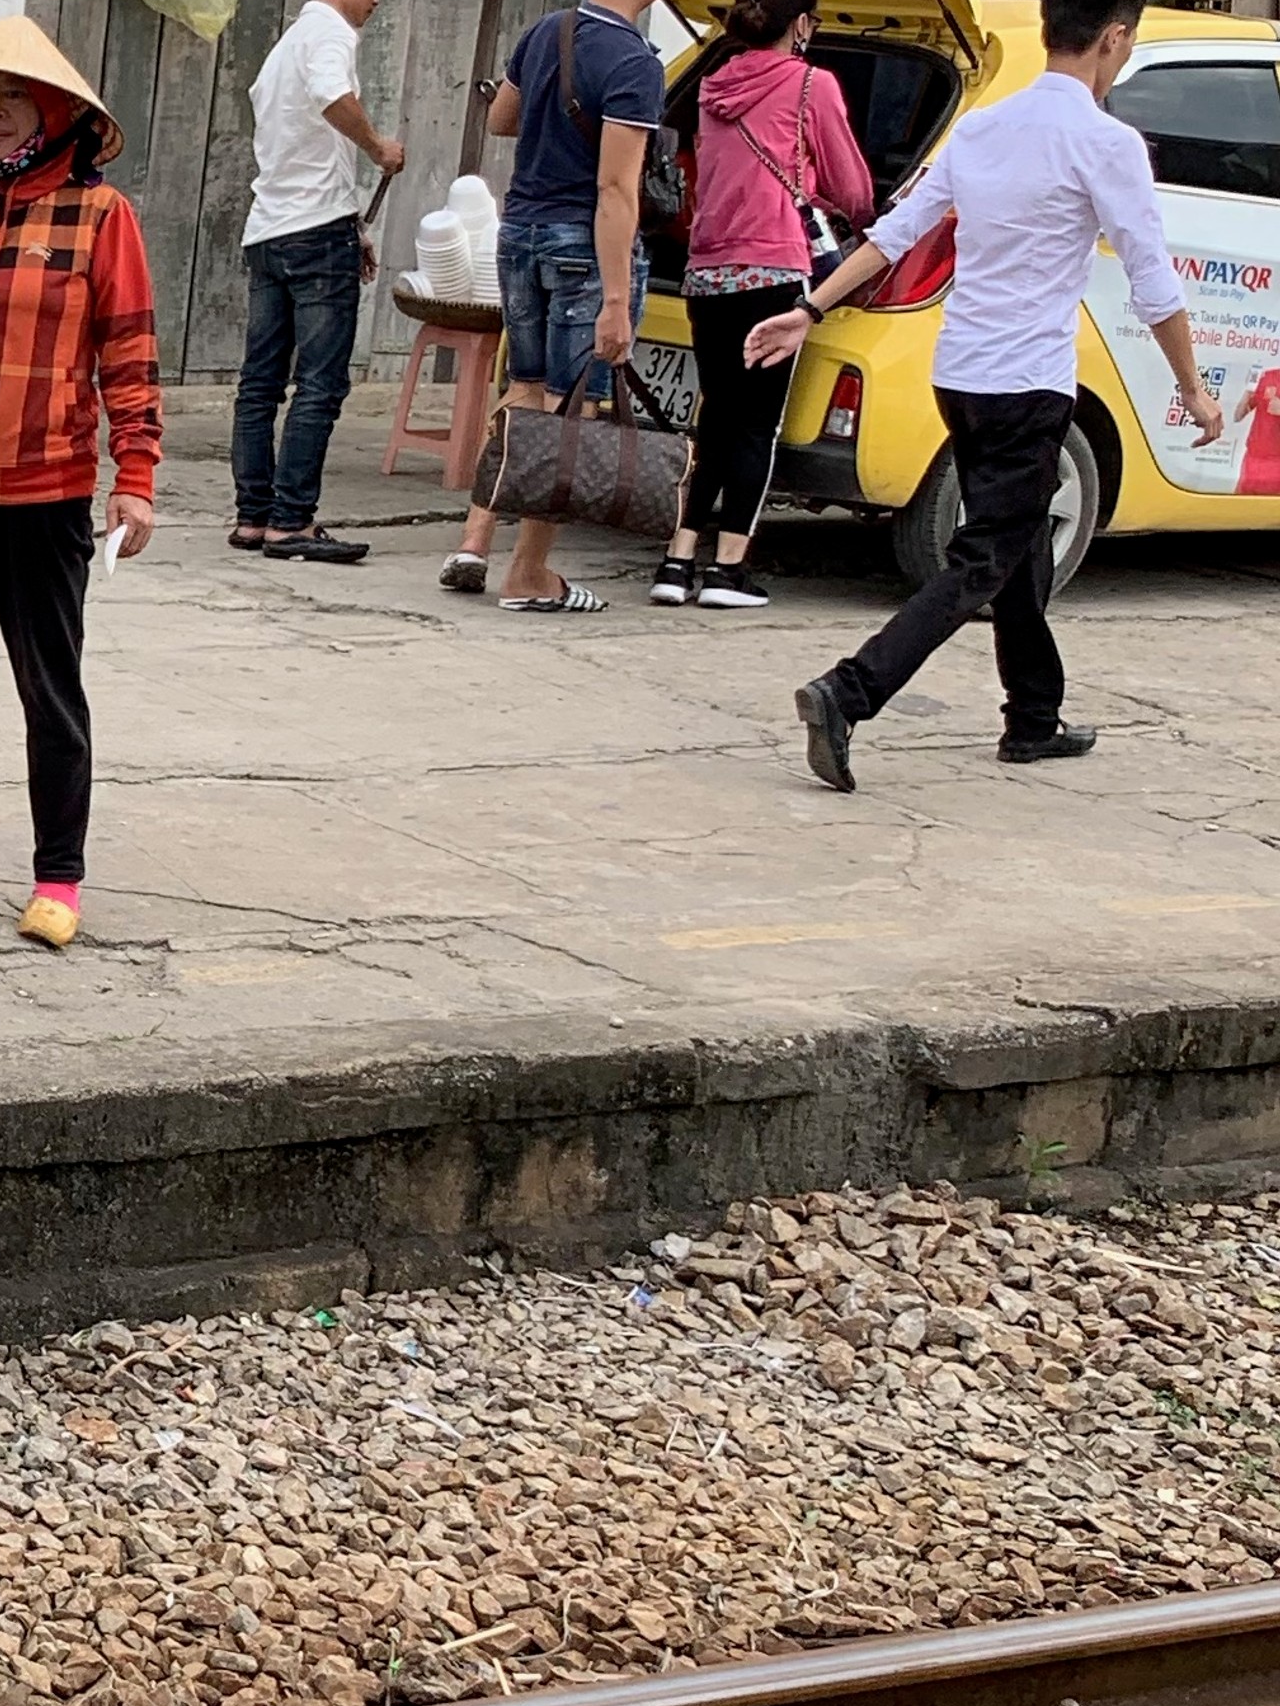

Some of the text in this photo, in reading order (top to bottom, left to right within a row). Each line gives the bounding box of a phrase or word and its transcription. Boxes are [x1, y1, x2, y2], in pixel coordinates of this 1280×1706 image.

[1172, 257, 1272, 293] VNPAYQR
[1243, 314, 1258, 329] QR
[1260, 316, 1278, 333] Pay
[1191, 328, 1222, 346] obile
[1226, 329, 1279, 357] Banking
[645, 346, 686, 385] 37A
[633, 385, 694, 423] 43
